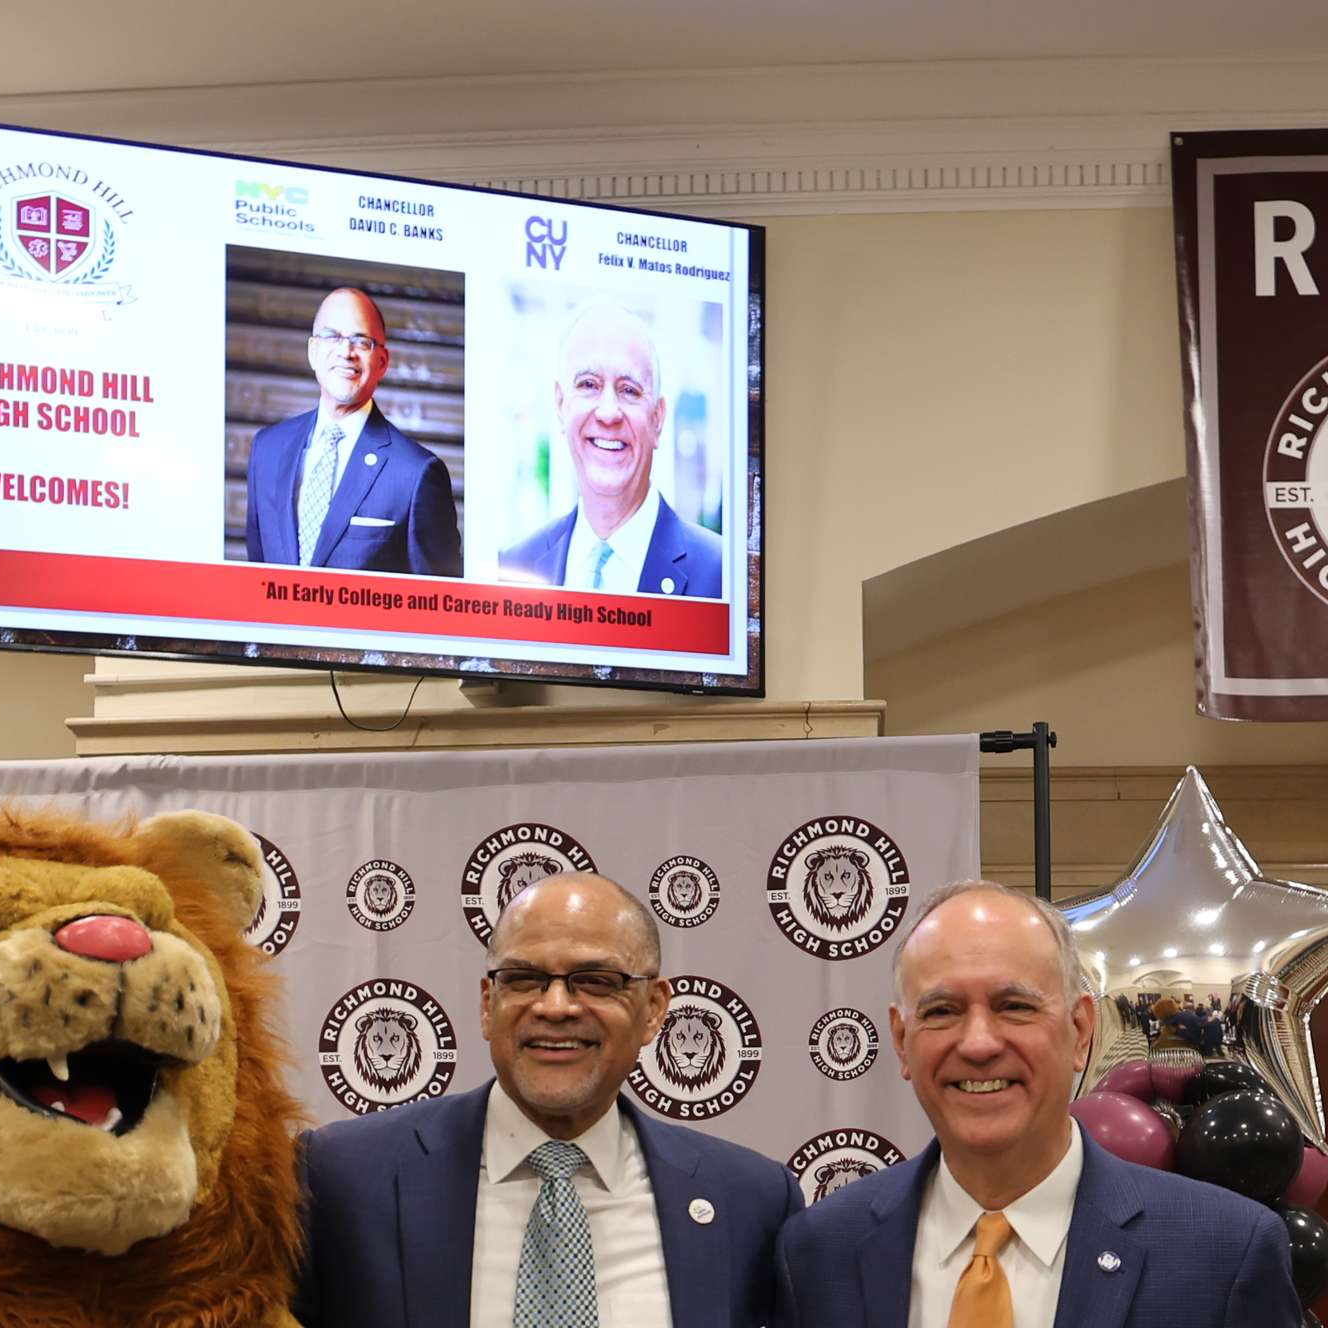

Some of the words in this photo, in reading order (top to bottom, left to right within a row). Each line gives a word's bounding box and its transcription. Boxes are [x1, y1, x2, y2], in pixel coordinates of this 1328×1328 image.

[92, 180, 134, 224] HILL
[235, 200, 297, 217] Public
[358, 195, 434, 217] CHANCELLOR
[235, 213, 315, 232] Schools
[349, 217, 386, 234] DAVID
[404, 224, 443, 241] BANKS
[617, 231, 688, 253] CHANCELLOR
[638, 258, 673, 274] Matos
[102, 372, 154, 403] HILL
[37, 402, 140, 438] SCHOOL
[1275, 486, 1314, 503] EST.
[292, 583, 334, 606] Early
[338, 587, 403, 610] College
[407, 594, 438, 611] and
[442, 594, 500, 616] Career
[503, 599, 553, 621] Ready
[556, 603, 593, 624] High
[597, 606, 652, 627] School
[466, 826, 563, 884] RICHMOND
[772, 819, 870, 879] RICHMOND
[874, 836, 905, 883] HILL
[266, 850, 296, 897] HILL
[348, 861, 396, 893] RICHMOND
[398, 870, 413, 894] HILL
[651, 857, 700, 888] RICHMOND
[702, 866, 718, 891] HILL
[277, 900, 299, 909] 1899
[465, 896, 485, 905] EST.
[771, 892, 791, 901] EST.
[885, 885, 907, 895] 1899
[351, 906, 372, 928] HIGH
[375, 905, 412, 930] SCHOOL
[653, 902, 676, 924] HIGH
[678, 902, 717, 927] SCHOOL
[776, 909, 821, 953] HIGH
[828, 906, 902, 957] SCHOOL
[323, 982, 418, 1042] RICHMOND
[422, 1000, 452, 1048] HILL
[726, 998, 757, 1046] HILL
[811, 1009, 859, 1041] RICHMOND
[861, 1018, 877, 1042] HILL
[323, 1054, 342, 1063] EST.
[433, 1051, 455, 1060] 1899
[737, 1049, 759, 1058] 1899
[813, 1055, 835, 1078] HIGH
[838, 1054, 875, 1080] SCHOOL
[327, 1071, 370, 1114] HIGH
[629, 1068, 673, 1113] HIGH
[679, 1069, 755, 1117] SCHOOL
